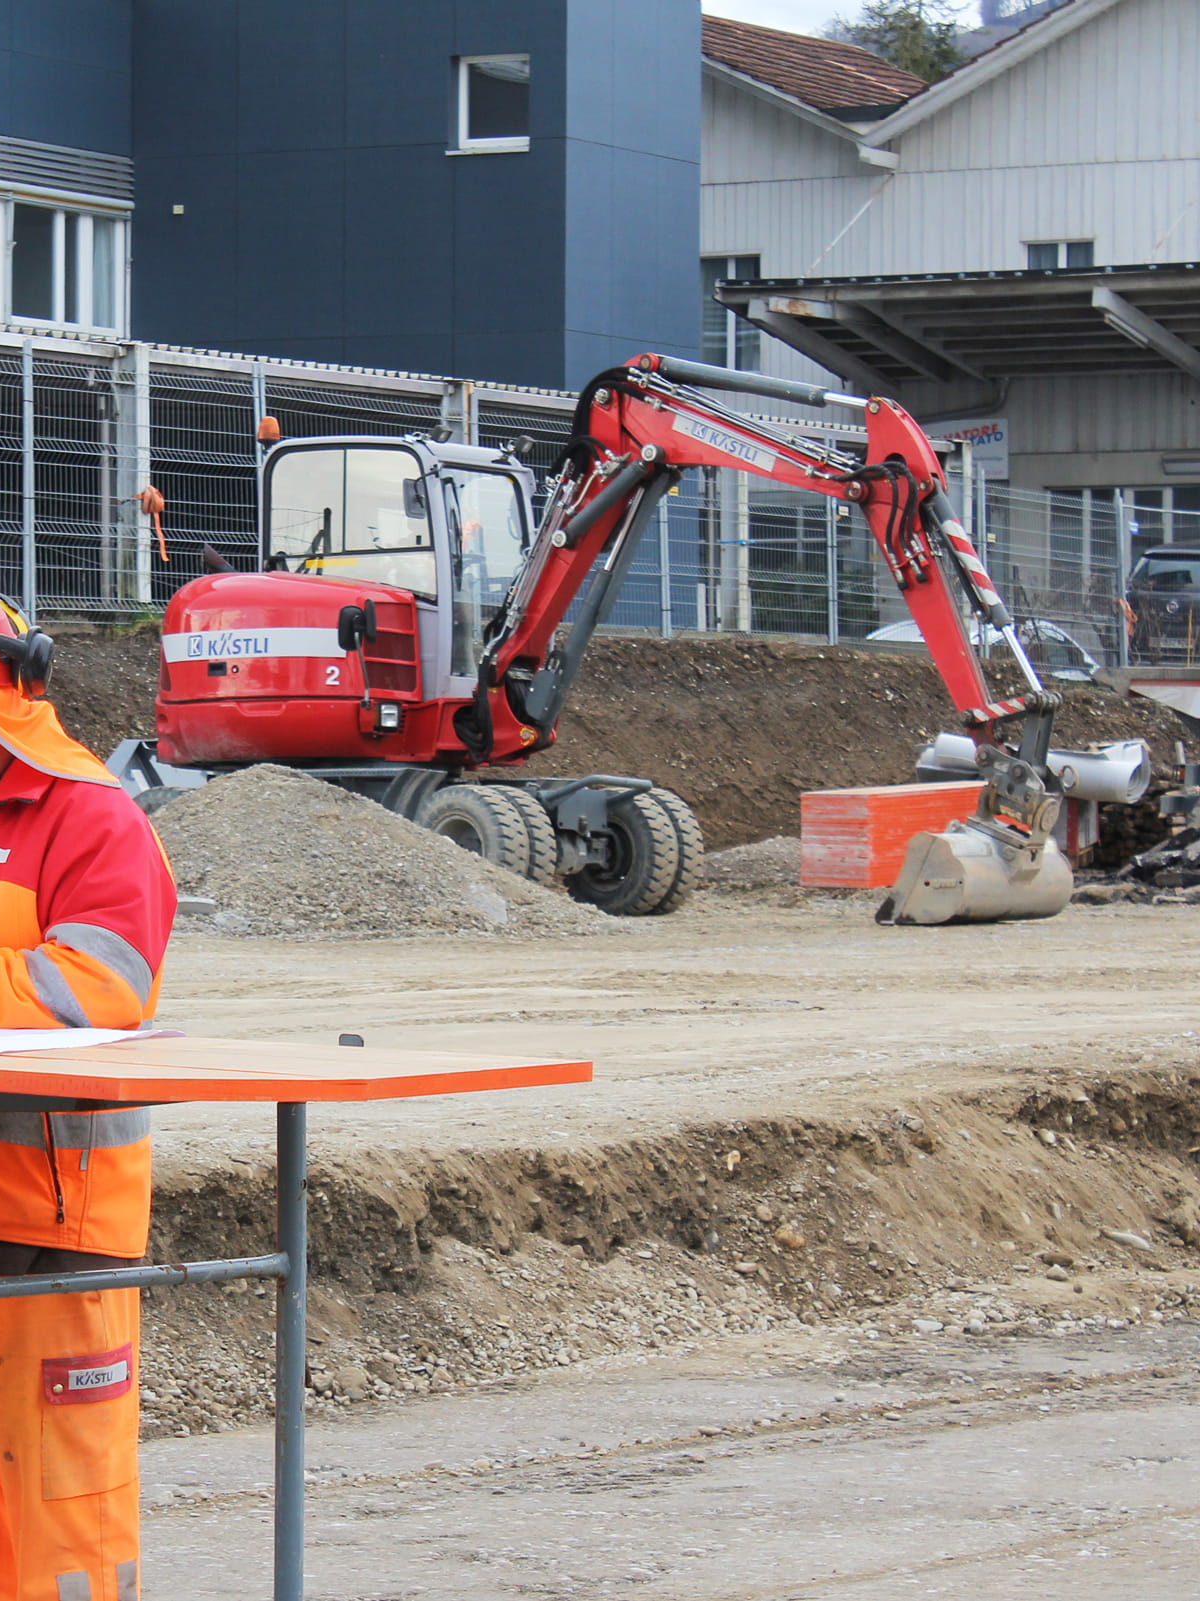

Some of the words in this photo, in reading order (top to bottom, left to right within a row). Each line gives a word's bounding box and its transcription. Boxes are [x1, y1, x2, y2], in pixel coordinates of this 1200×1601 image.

[208, 633, 268, 656] KÄSTLI
[325, 666, 340, 686] 2
[75, 1371, 113, 1386] KÄSTLI
